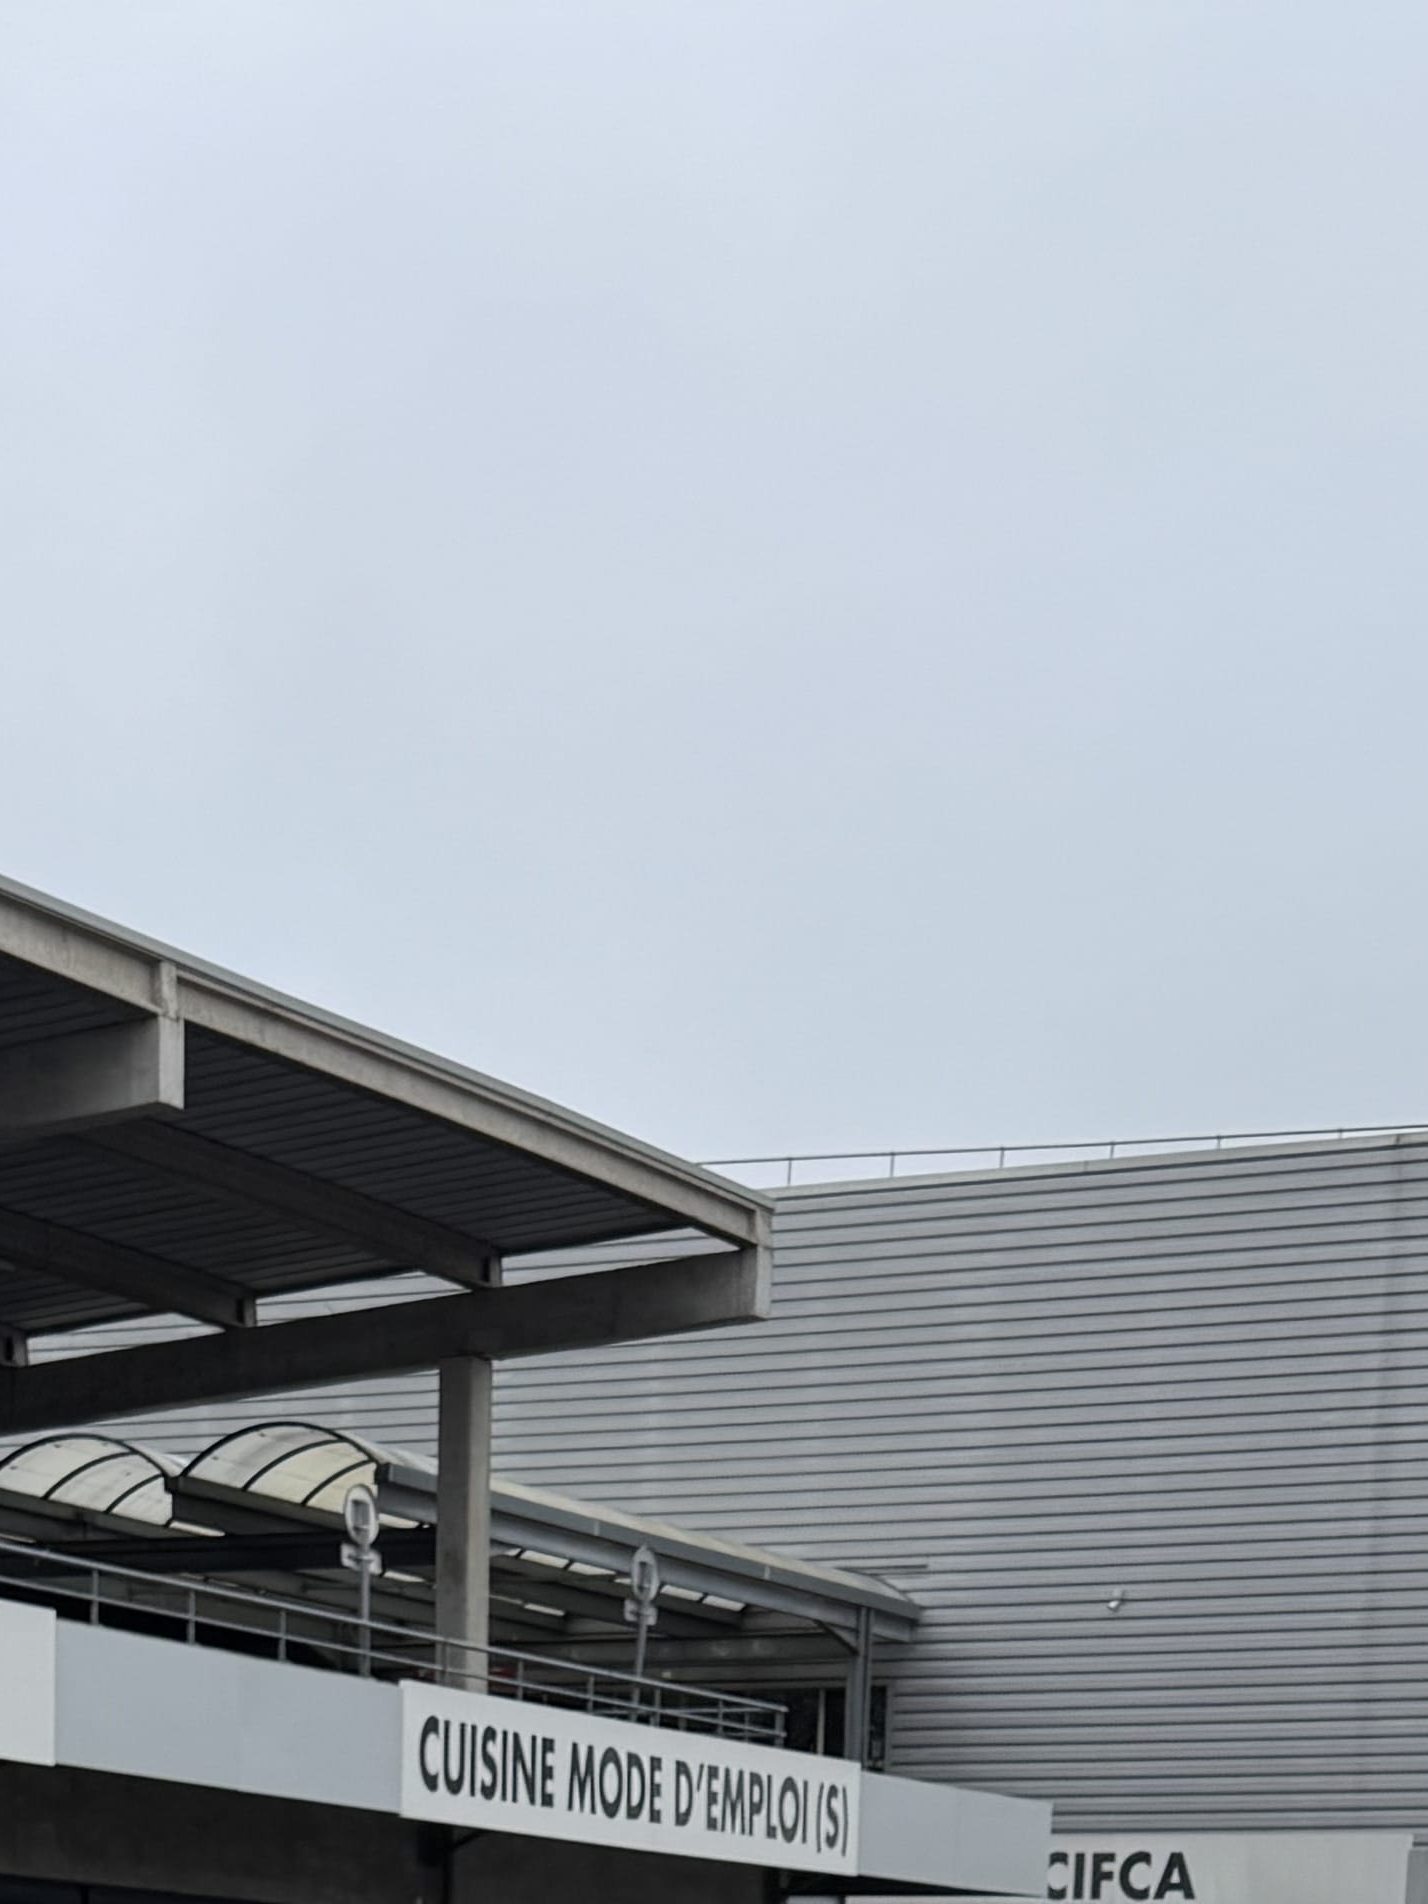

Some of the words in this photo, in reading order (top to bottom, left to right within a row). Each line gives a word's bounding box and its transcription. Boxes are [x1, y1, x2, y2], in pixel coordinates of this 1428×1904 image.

[419, 1715, 555, 1808] CUISINE
[567, 1741, 662, 1824] MODE
[1046, 1851, 1196, 1901] CIFCA
